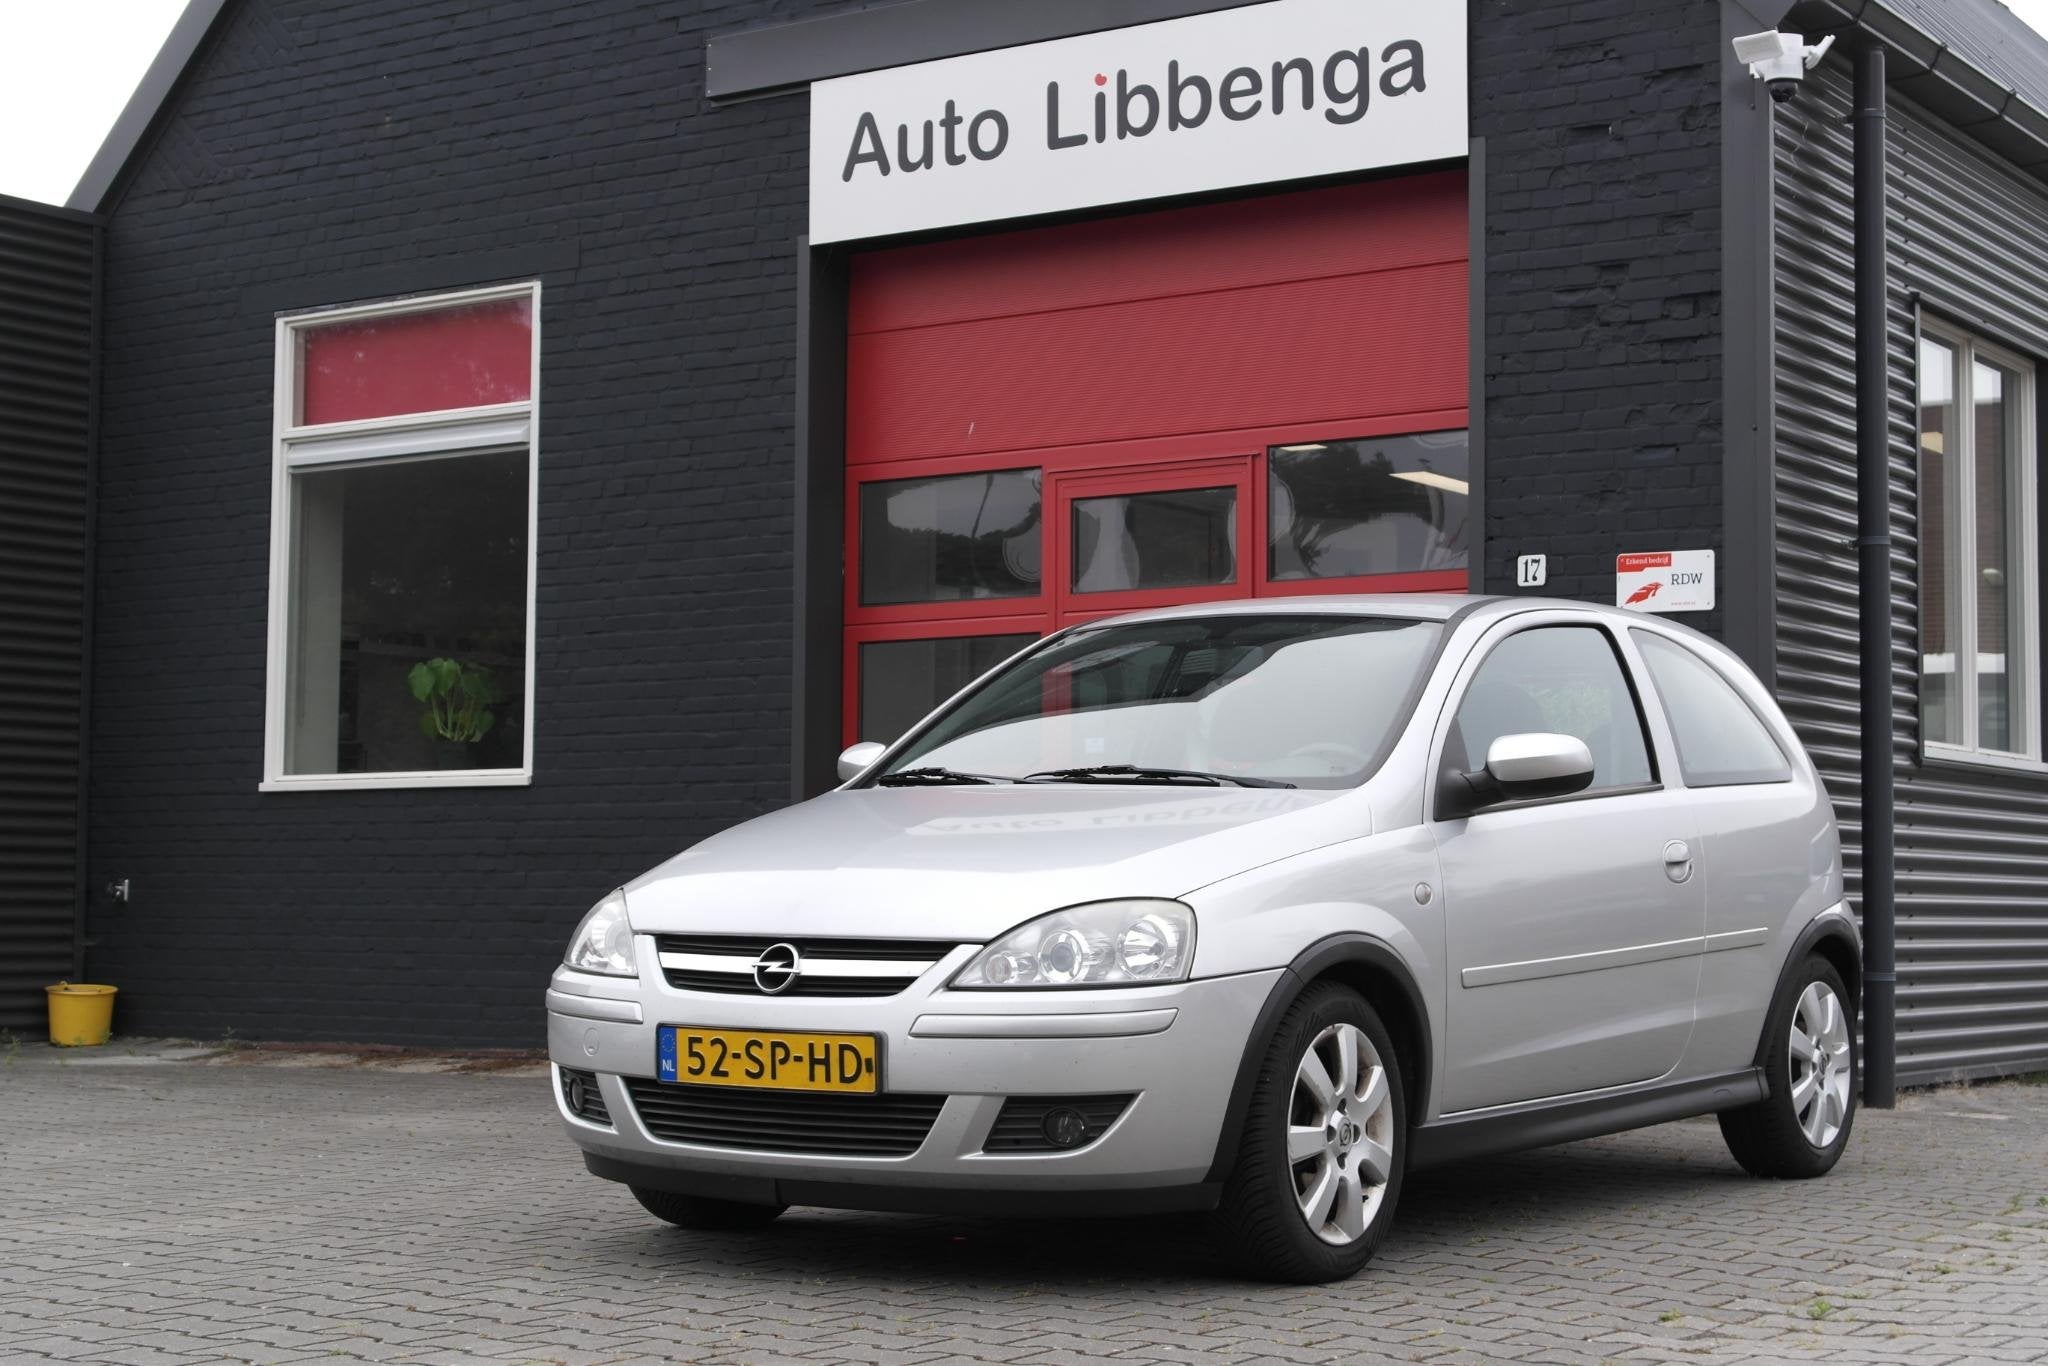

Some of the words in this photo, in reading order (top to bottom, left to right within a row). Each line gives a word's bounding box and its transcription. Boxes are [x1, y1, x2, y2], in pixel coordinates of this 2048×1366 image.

[842, 99, 1010, 183] Auto
[1046, 38, 1427, 150] Libbenga
[1625, 557, 1647, 565] Erkend
[1648, 555, 1669, 564] bedrijf
[1522, 558, 1541, 583] 17
[1671, 573, 1703, 586] RDW
[662, 1058, 676, 1072] NL
[687, 1036, 863, 1084] 52-SP-HD
